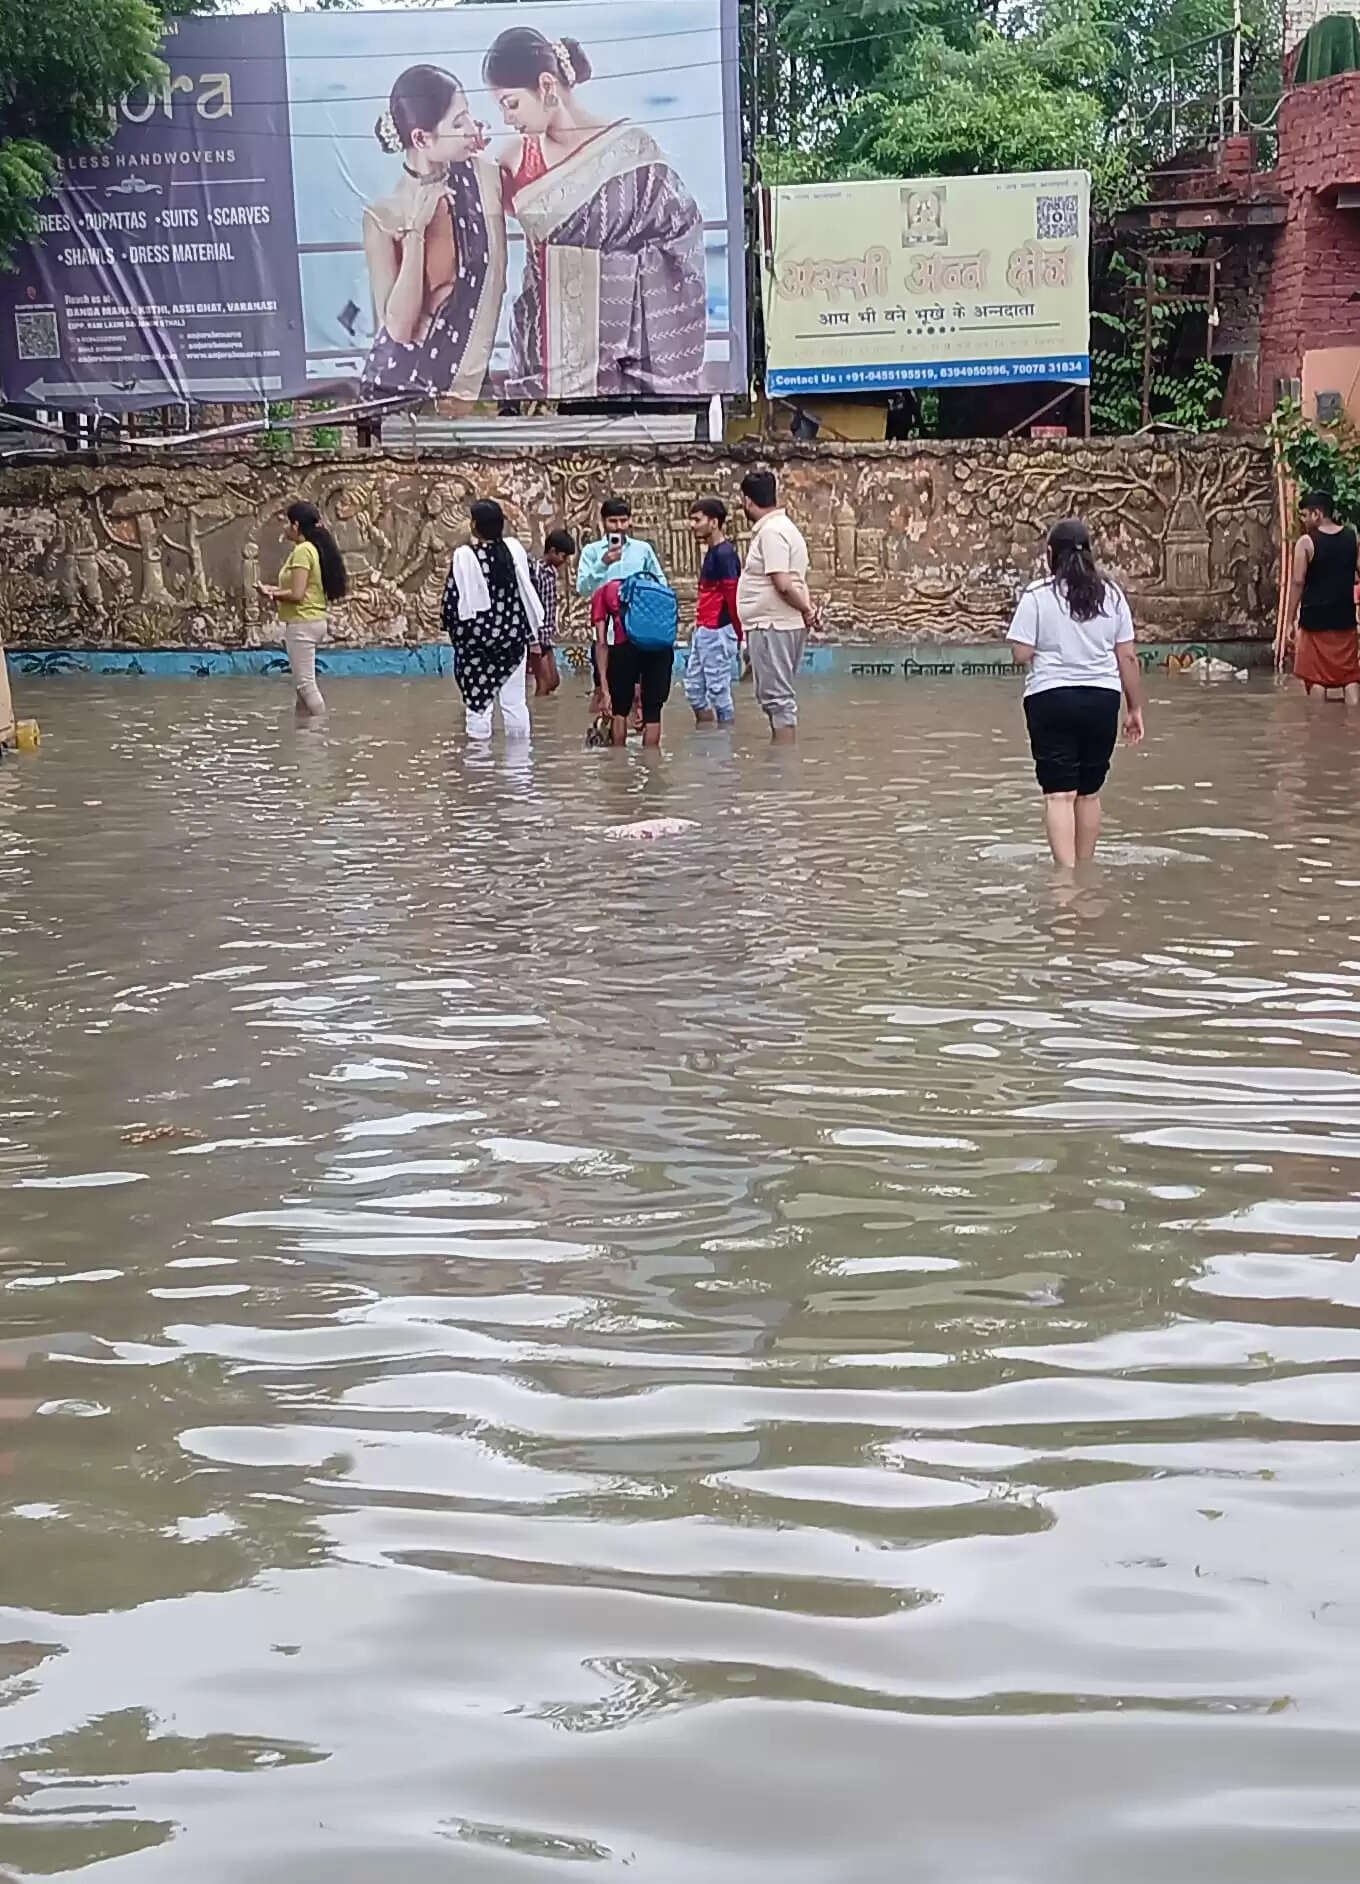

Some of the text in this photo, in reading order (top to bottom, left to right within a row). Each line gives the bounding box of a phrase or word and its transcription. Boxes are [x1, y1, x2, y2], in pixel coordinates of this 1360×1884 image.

[116, 149, 236, 167] HANDWOVENS
[86, 211, 147, 230] DUPATTAS
[162, 209, 198, 227] SUITS
[214, 206, 270, 225] SCARVES
[64, 243, 234, 266] SHAWLS DRESS MATERIAL
[819, 311, 850, 326] आप
[859, 307, 876, 324] भी
[915, 303, 945, 327] भूखे
[952, 302, 966, 319] के
[974, 302, 1035, 318] अन्नदाता
[776, 374, 818, 385] Contact
[821, 374, 836, 383] Us
[851, 663, 895, 677] नगर
